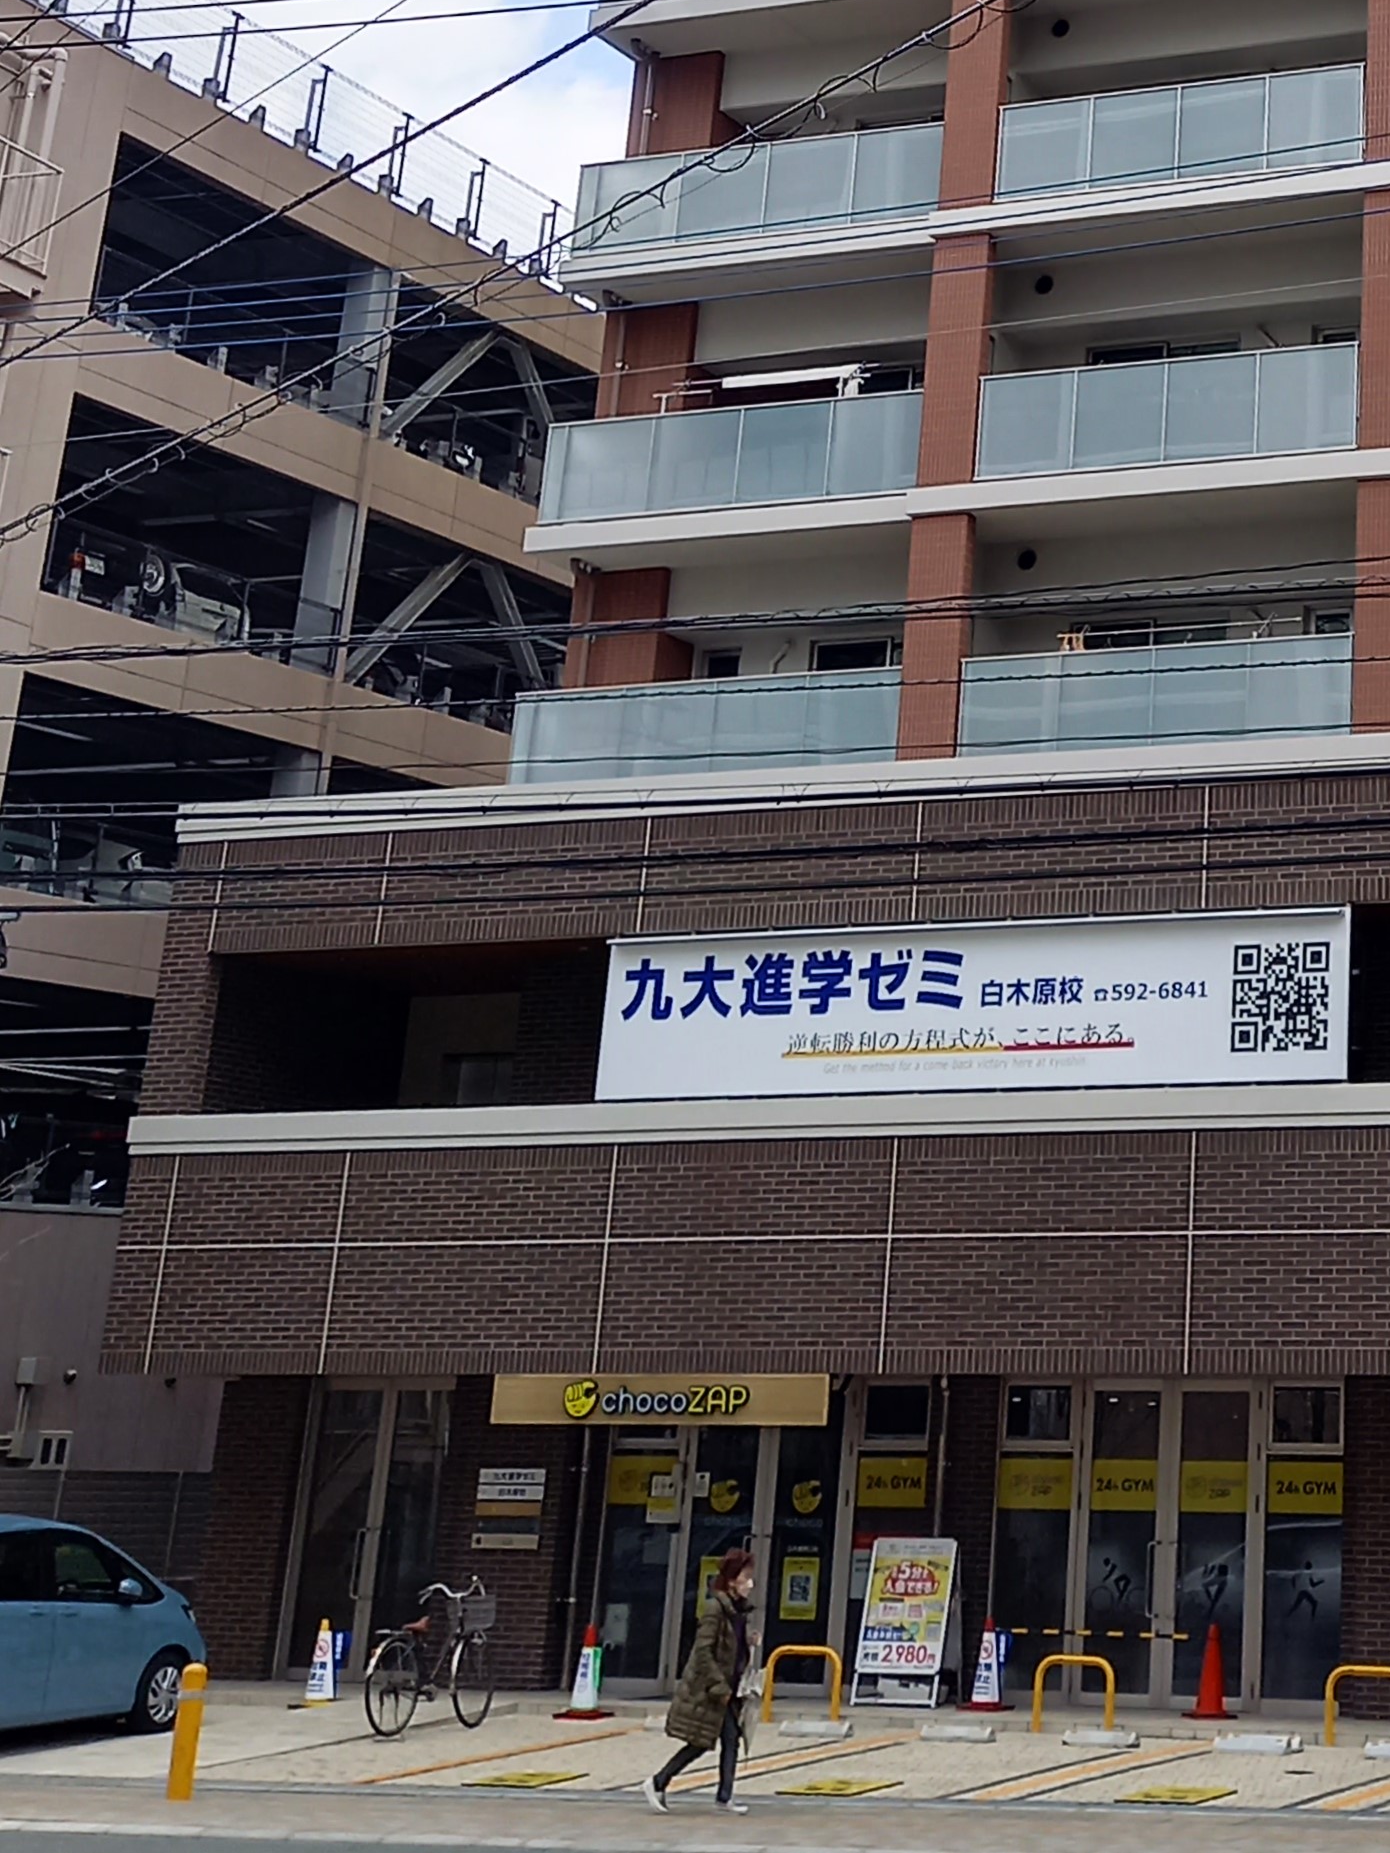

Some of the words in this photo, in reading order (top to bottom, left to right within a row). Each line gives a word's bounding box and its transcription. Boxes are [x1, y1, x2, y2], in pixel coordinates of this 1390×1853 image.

[621, 949, 964, 1021] 九大進学ゼミ
[980, 976, 1084, 1008] 白木原校
[1111, 981, 1208, 1001] 592-6841
[786, 1023, 1135, 1055] 逆転勝利の方程式が、ここにある。
[824, 1062, 840, 1074] Get
[842, 1061, 857, 1073] the
[860, 1059, 895, 1073] method
[898, 1059, 912, 1072] for
[923, 1060, 948, 1071] come
[951, 1058, 974, 1070] back
[977, 1057, 1008, 1071] victory
[1012, 1057, 1034, 1069] here
[1036, 1057, 1046, 1067] at
[601, 1385, 748, 1415] chocoZAP
[889, 1475, 922, 1490] GYM
[1096, 1478, 1119, 1492] 24h
[1121, 1478, 1154, 1493] GYM
[1276, 1480, 1300, 1495] 24h
[1302, 1481, 1337, 1495] GYM
